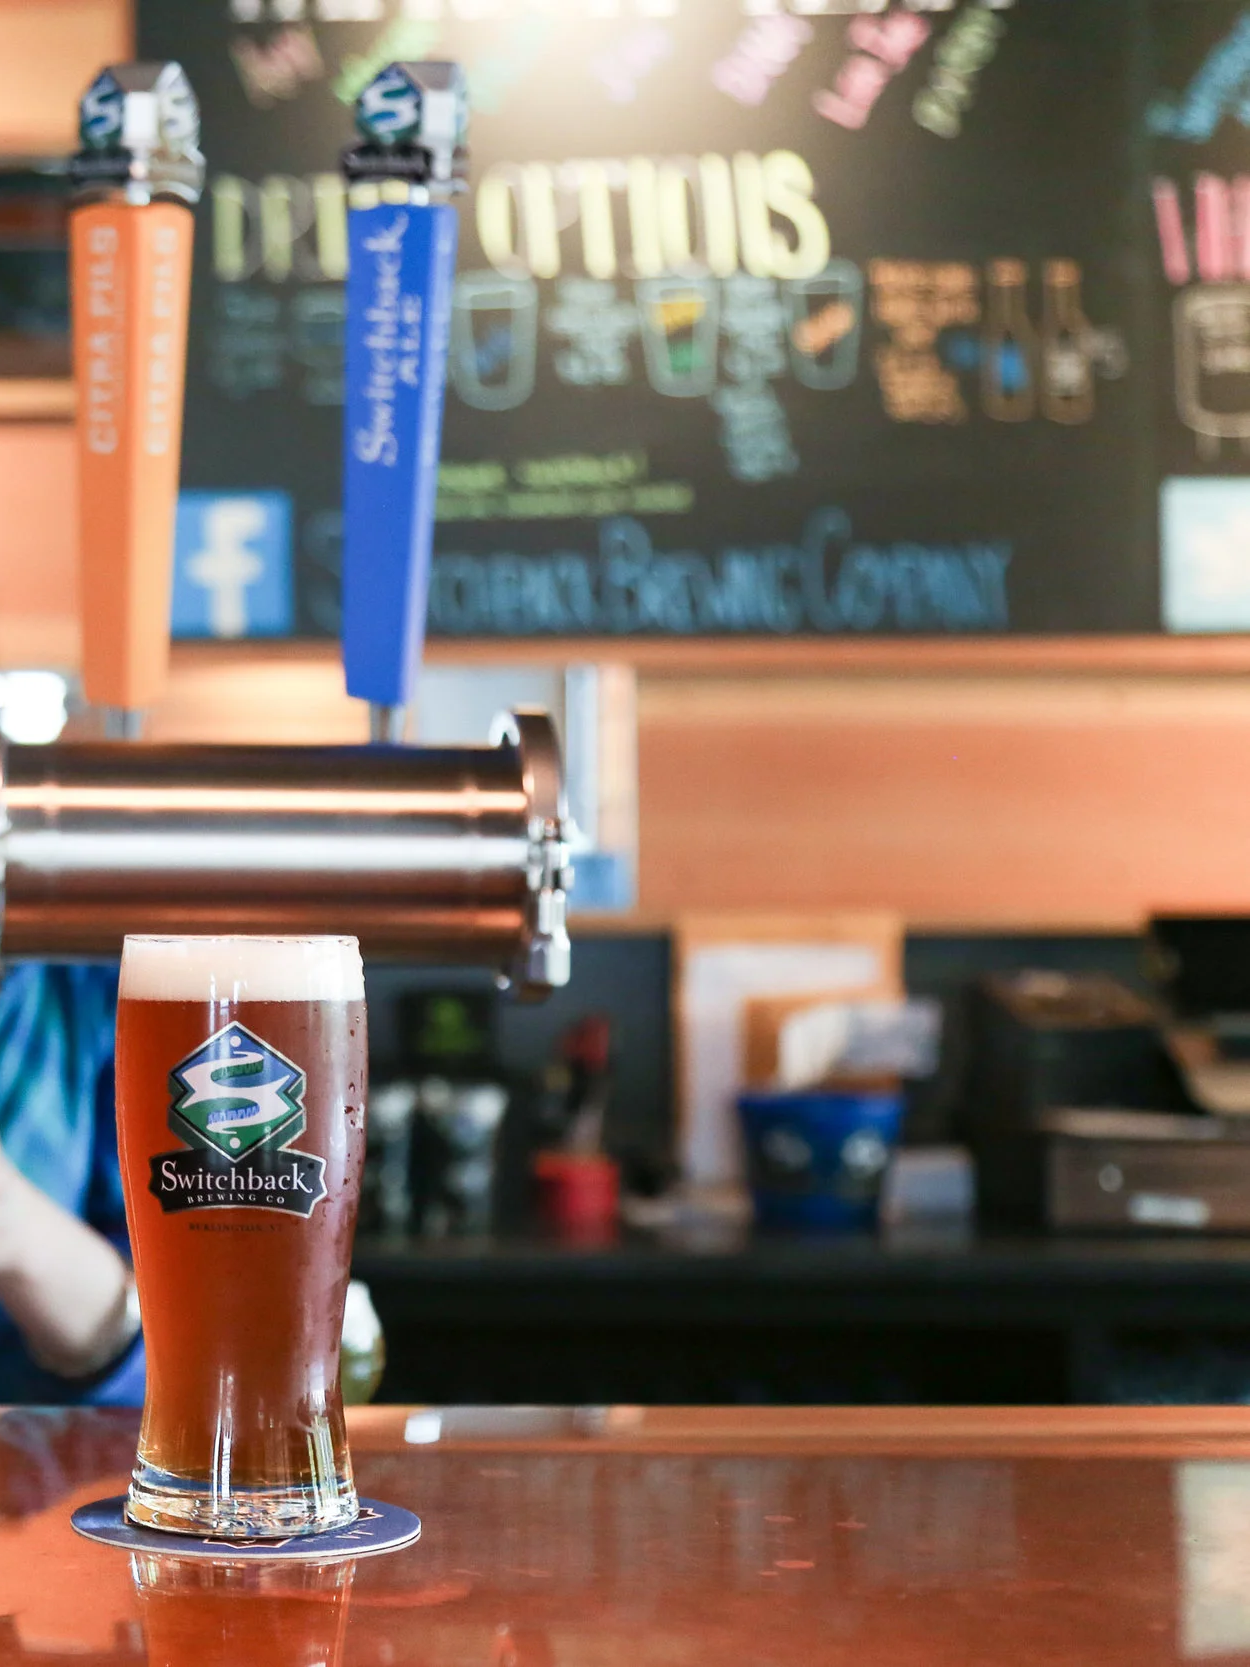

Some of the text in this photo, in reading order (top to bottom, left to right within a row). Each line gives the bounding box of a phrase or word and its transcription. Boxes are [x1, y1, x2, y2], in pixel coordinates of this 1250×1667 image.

[477, 150, 830, 282] OPTIONS
[86, 331, 119, 455] CITRA
[354, 212, 410, 469] Switchback
[161, 1160, 313, 1194] Switchback
[187, 1193, 257, 1204] BREWING
